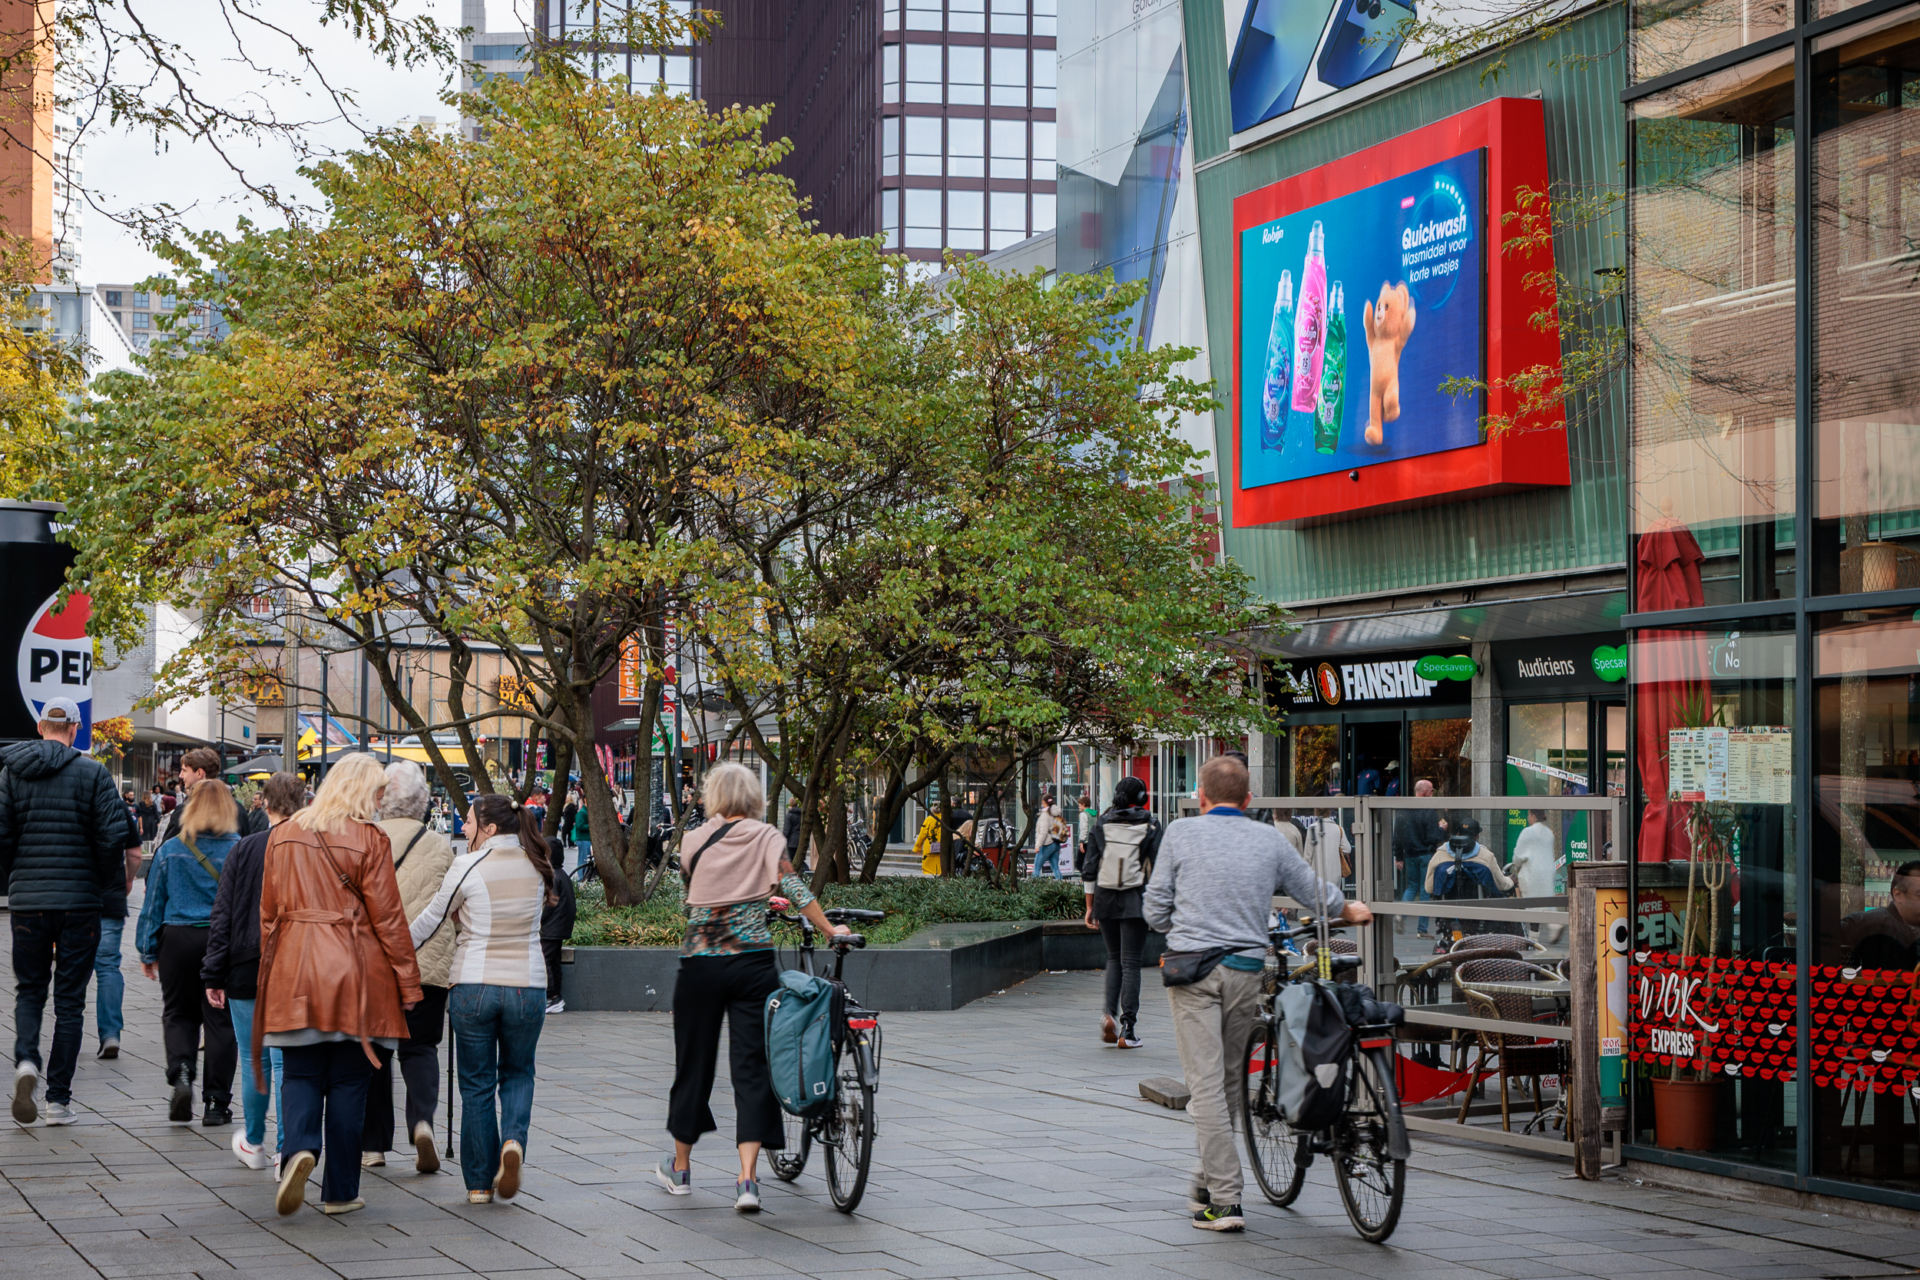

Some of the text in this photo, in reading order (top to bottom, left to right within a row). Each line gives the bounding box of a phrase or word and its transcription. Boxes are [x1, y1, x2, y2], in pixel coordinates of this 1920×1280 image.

[1133, 0, 1162, 14] Gala
[1262, 225, 1284, 245] Robijn
[1402, 211, 1467, 250] Quickwash
[1402, 237, 1467, 267] Wasmiddel voor
[1409, 258, 1459, 283] korte wasjes
[1300, 325, 1317, 340] Robijn
[1302, 357, 1309, 367] 15
[1423, 662, 1474, 673] Specsavers
[1518, 657, 1576, 678] Audiciens
[499, 690, 534, 706] PLA
[1509, 817, 1527, 828] meting
[1570, 840, 1588, 849] Gratis
[1571, 850, 1588, 858] hoor-
[1640, 972, 1719, 1032] WOK
[1602, 1038, 1620, 1047] WOK
[1651, 1028, 1694, 1056] EXPRESS
[1603, 1047, 1620, 1055] EXPRESS
